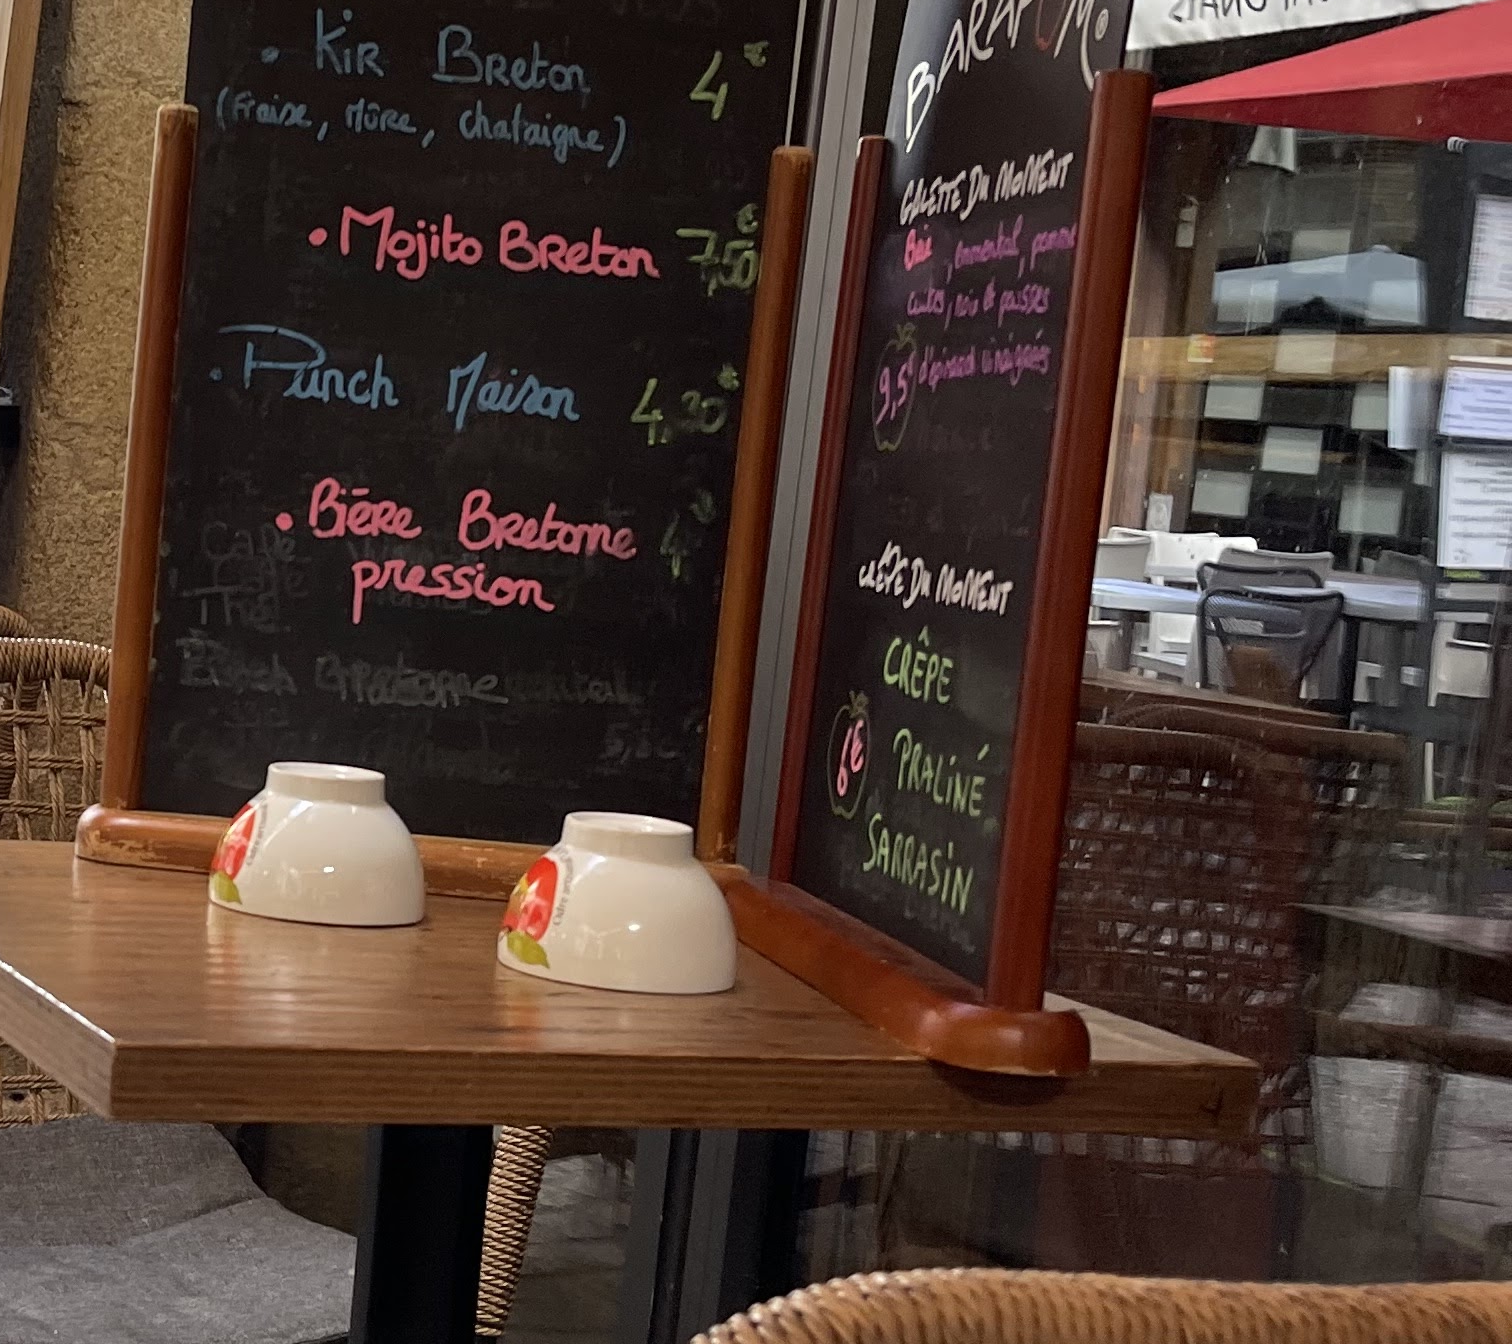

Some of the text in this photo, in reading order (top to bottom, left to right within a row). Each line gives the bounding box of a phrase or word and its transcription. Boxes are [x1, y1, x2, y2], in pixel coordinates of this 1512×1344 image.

[339, 205, 482, 280] Mojito
[217, 324, 399, 410] Punch
[350, 556, 557, 627] pression
[884, 624, 955, 706] CRÊPE
